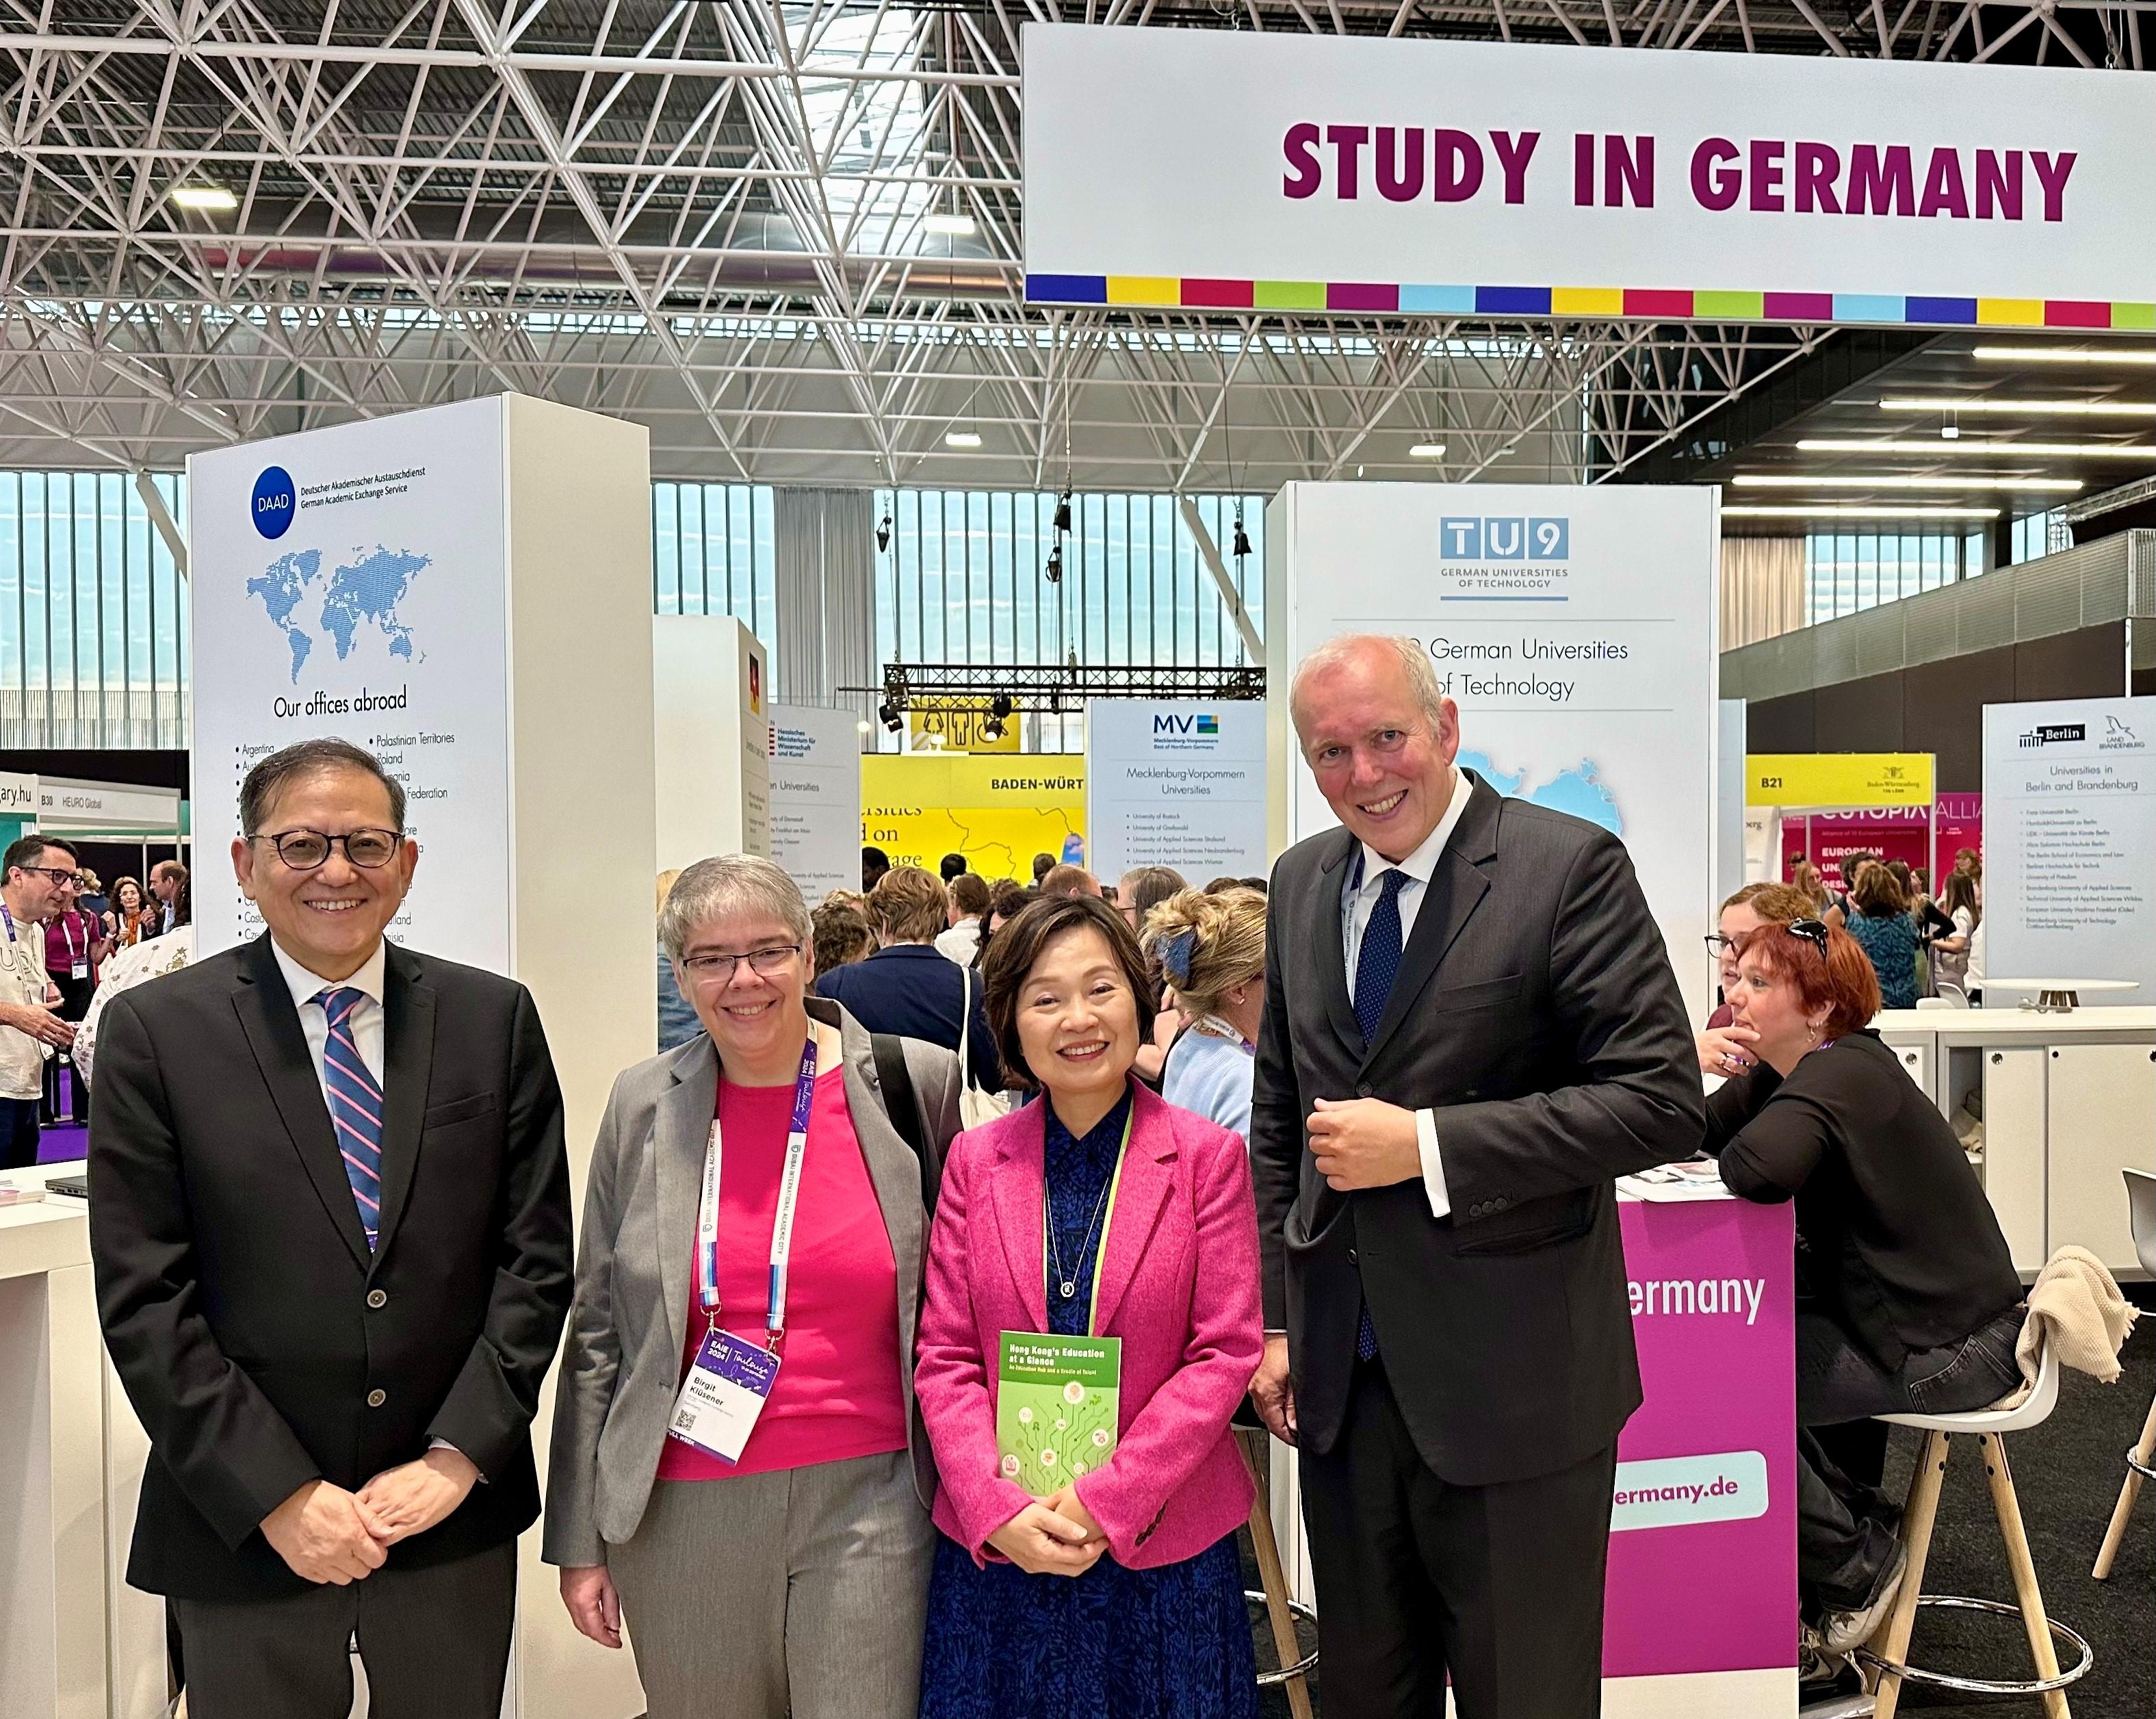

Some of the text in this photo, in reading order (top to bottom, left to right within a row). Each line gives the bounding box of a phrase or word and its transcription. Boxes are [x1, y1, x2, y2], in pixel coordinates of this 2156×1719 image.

[1283, 122, 2078, 223] STUDY IN GERMANY
[301, 467, 426, 496] Deutscher Akademischer Austauschdienst
[257, 493, 289, 513] DAAD
[301, 484, 408, 508] German Academic Exchange Service
[1444, 520, 1564, 557] TU9
[1441, 568, 1568, 578] GERMAN UNIVERSITIES
[1459, 579, 1551, 589] OF TECHNOLOGY
[1430, 637, 1512, 660] German
[1522, 638, 1628, 660] Universities
[1438, 672, 1575, 701] of Technology
[274, 684, 406, 718] Our offices abroad
[1154, 714, 1194, 734] MV
[419, 732, 455, 744] Territories
[2046, 728, 2080, 740] Berlin
[242, 743, 274, 758] Argentina
[2099, 742, 2146, 750] BRANDENBURG
[378, 750, 402, 764] Poland
[1126, 767, 1245, 781] Mecklenburg-Vorpommern
[2050, 765, 2113, 776] Universities in
[780, 780, 820, 792] Universities
[991, 777, 1085, 790] BADEN-WÜRT
[1162, 784, 1211, 795] Universities
[1761, 778, 1782, 788] B21
[2025, 779, 2138, 792] Berlin and Brandenburg
[0, 784, 31, 806] ary.hu
[407, 785, 448, 799] Federation
[41, 795, 101, 810] B30 HEURO Global
[874, 829, 899, 842] on
[1821, 846, 1884, 857] EUROPEAN
[784, 1169, 795, 1213] INTERNATIONAL
[779, 1213, 789, 1240] ACADEMIC
[1628, 1278, 1765, 1326] ermany
[711, 1340, 729, 1354] EAIE
[1009, 1344, 1105, 1358] Hong Kong's Education
[707, 1348, 725, 1361] 2024
[1009, 1355, 1017, 1363] at
[1026, 1356, 1054, 1366] Glance
[694, 1376, 716, 1392] Birgit
[690, 1386, 724, 1406] Klüsener
[1614, 1475, 1738, 1505] ermany.de
